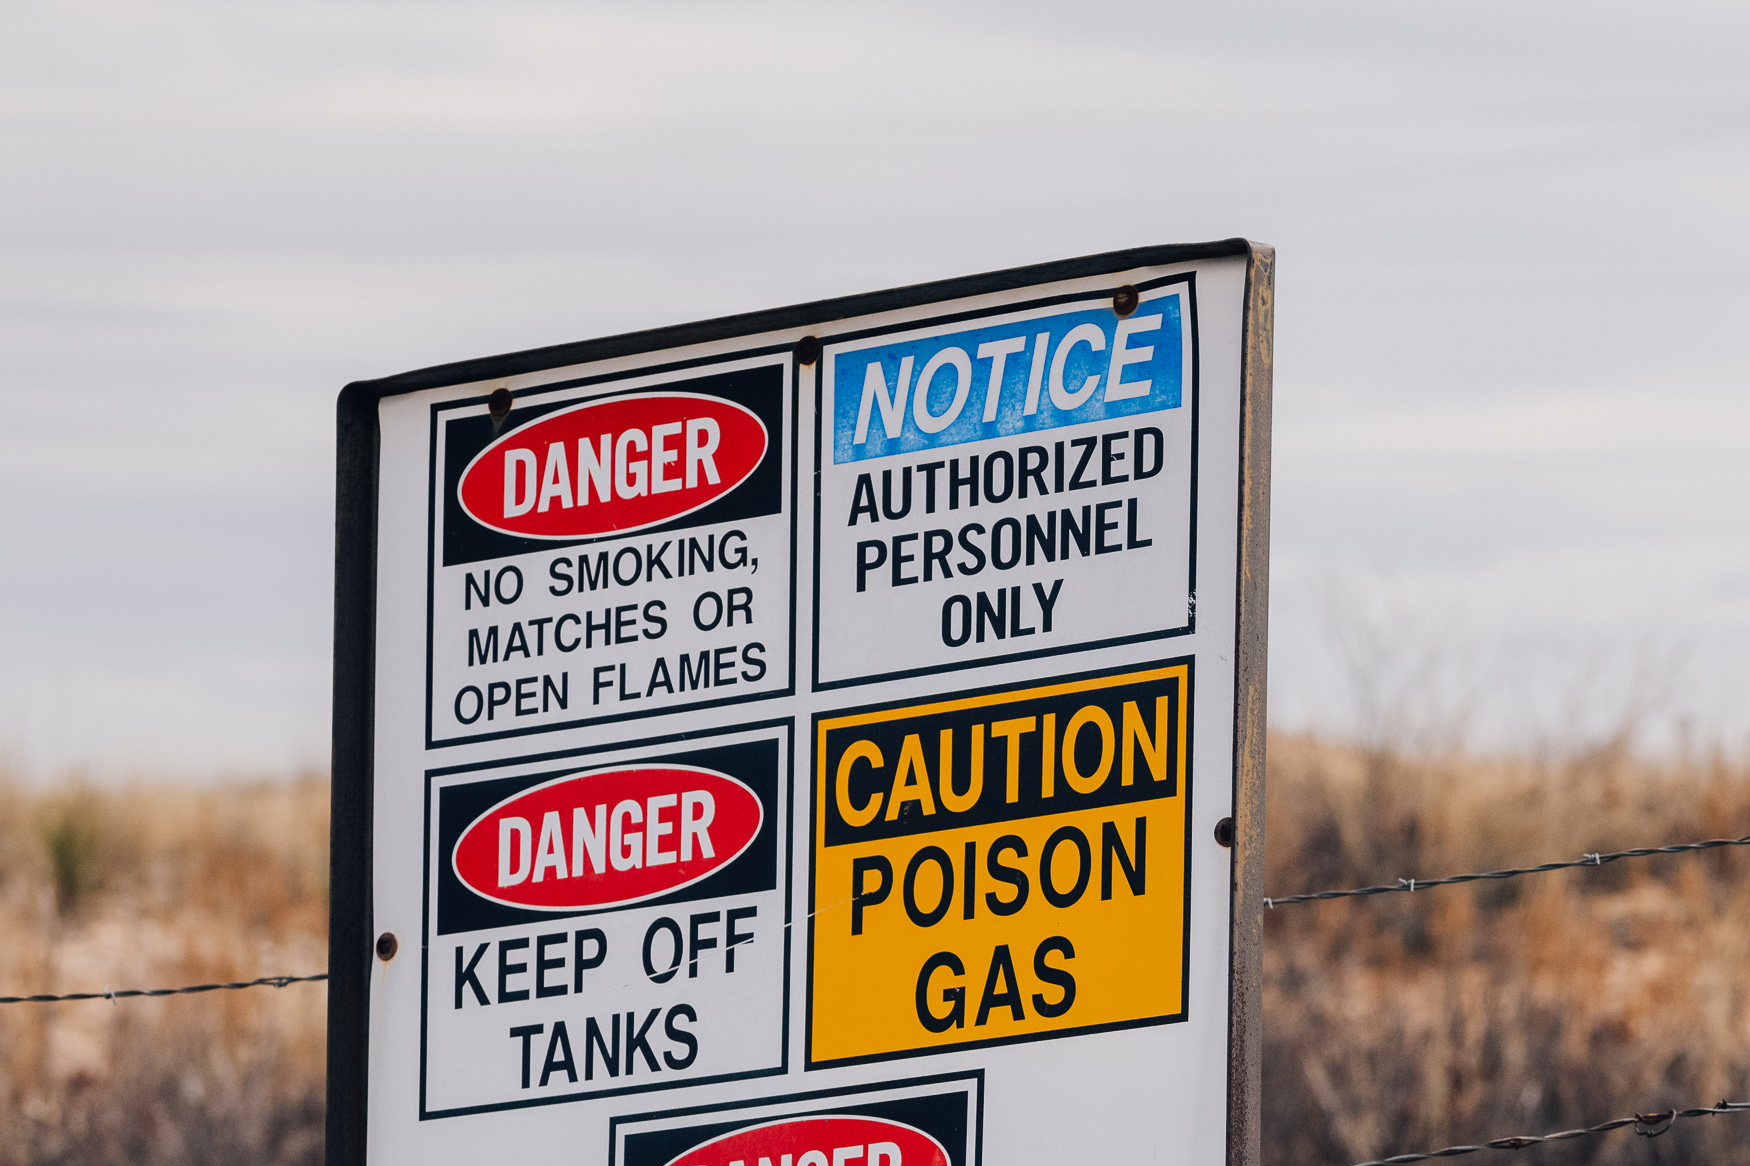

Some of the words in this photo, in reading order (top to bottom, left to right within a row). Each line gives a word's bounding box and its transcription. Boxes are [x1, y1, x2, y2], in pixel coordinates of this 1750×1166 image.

[852, 312, 1164, 446] NOTICE
[503, 416, 721, 519] DANGER
[847, 426, 1164, 528] AUTHORIZED
[464, 564, 524, 611] NO
[548, 529, 759, 597] SMOKING,
[855, 496, 1153, 594] PERSONNEL
[467, 599, 668, 668] MATCHES
[692, 585, 754, 632] OR
[940, 577, 1065, 649] ONLY
[453, 671, 569, 725] OPEN
[592, 641, 767, 706] FLAMES
[834, 694, 1169, 829] CAUTION
[497, 788, 716, 889] DANGER
[850, 815, 1148, 937] POISON
[453, 926, 608, 1011] KEEP
[641, 905, 758, 985] OFF
[914, 935, 1077, 1034] GAS
[509, 1002, 699, 1090] TANKS
